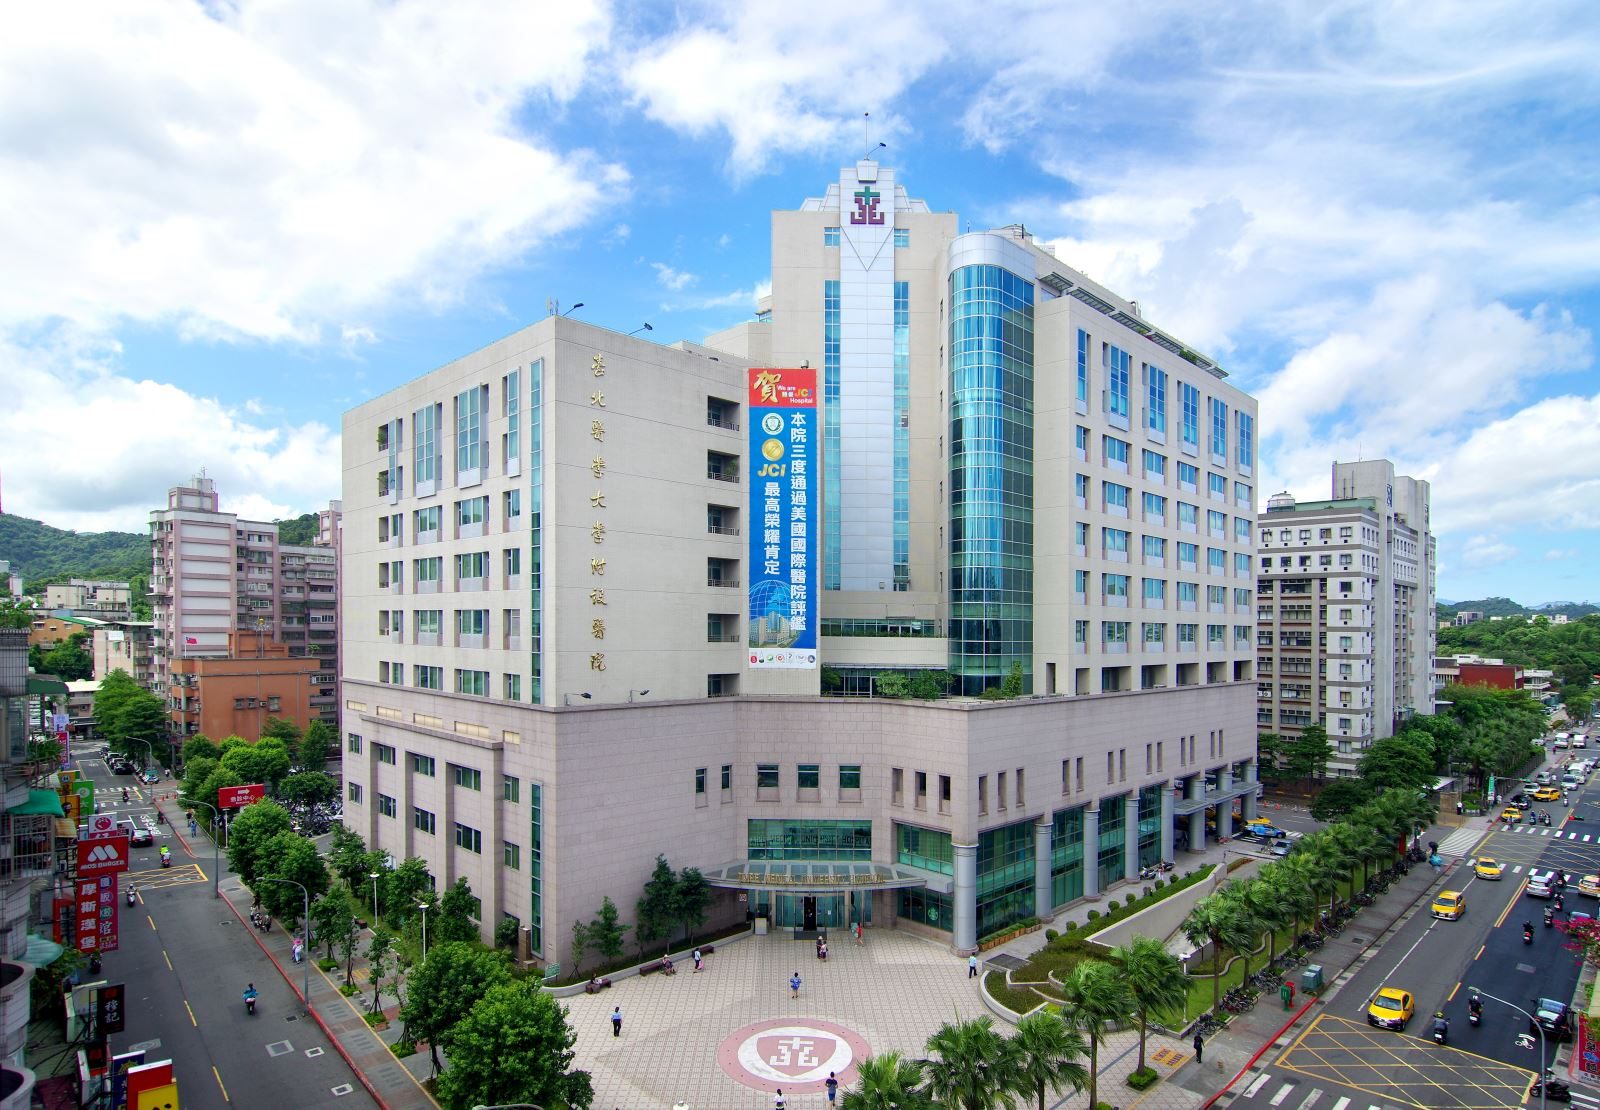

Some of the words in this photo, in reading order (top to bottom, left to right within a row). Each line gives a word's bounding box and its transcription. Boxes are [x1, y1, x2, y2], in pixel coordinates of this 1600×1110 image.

[753, 370, 782, 403] 賀
[795, 388, 812, 397] JCI
[757, 463, 786, 477] JCI
[764, 481, 781, 575] 最高榮耀肯定
[790, 411, 807, 631] 本院三度通過美國國際醫院評鑑
[80, 883, 97, 950] 摩斯漢堡
